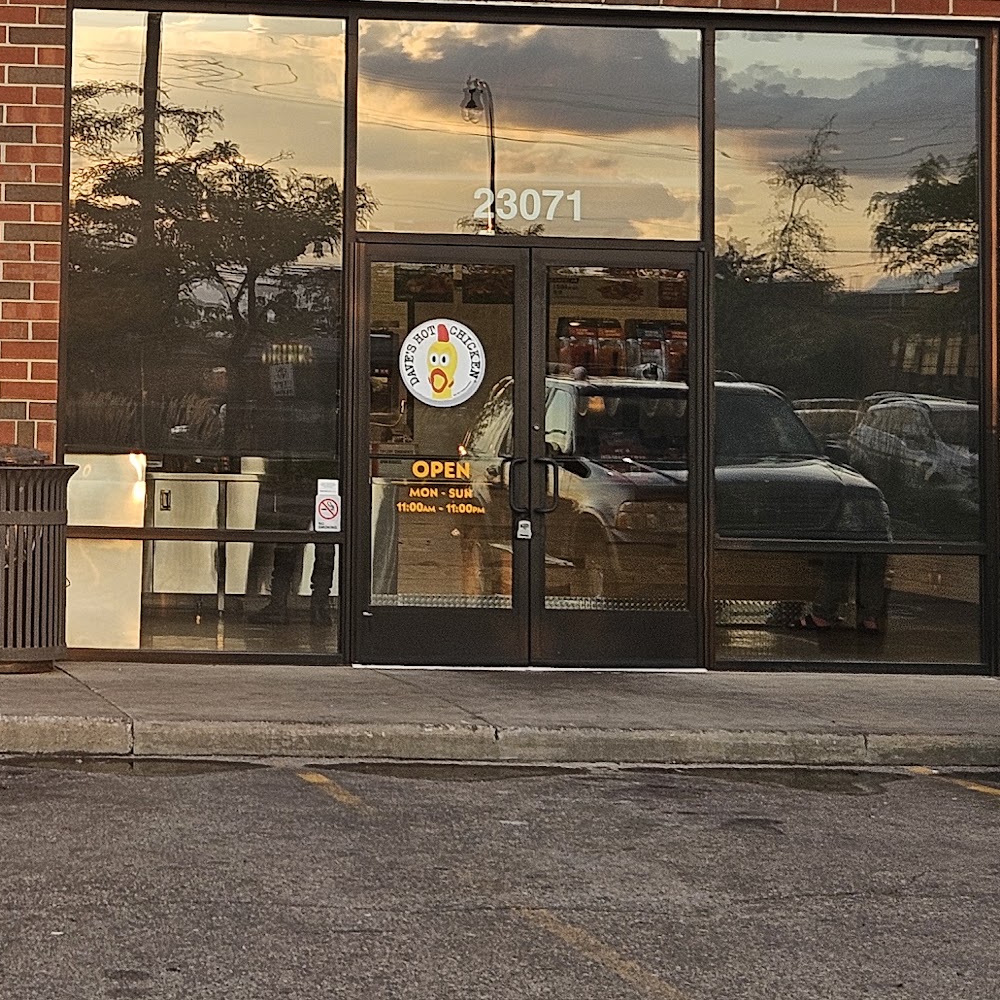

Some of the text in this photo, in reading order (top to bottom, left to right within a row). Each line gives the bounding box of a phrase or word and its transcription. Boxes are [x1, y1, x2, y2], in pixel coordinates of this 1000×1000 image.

[473, 187, 582, 221] 23071
[404, 325, 481, 387] DAVE'S HOT CHICKEN
[412, 460, 471, 479] OPEN
[409, 487, 438, 498] MON
[448, 488, 473, 499] SUN
